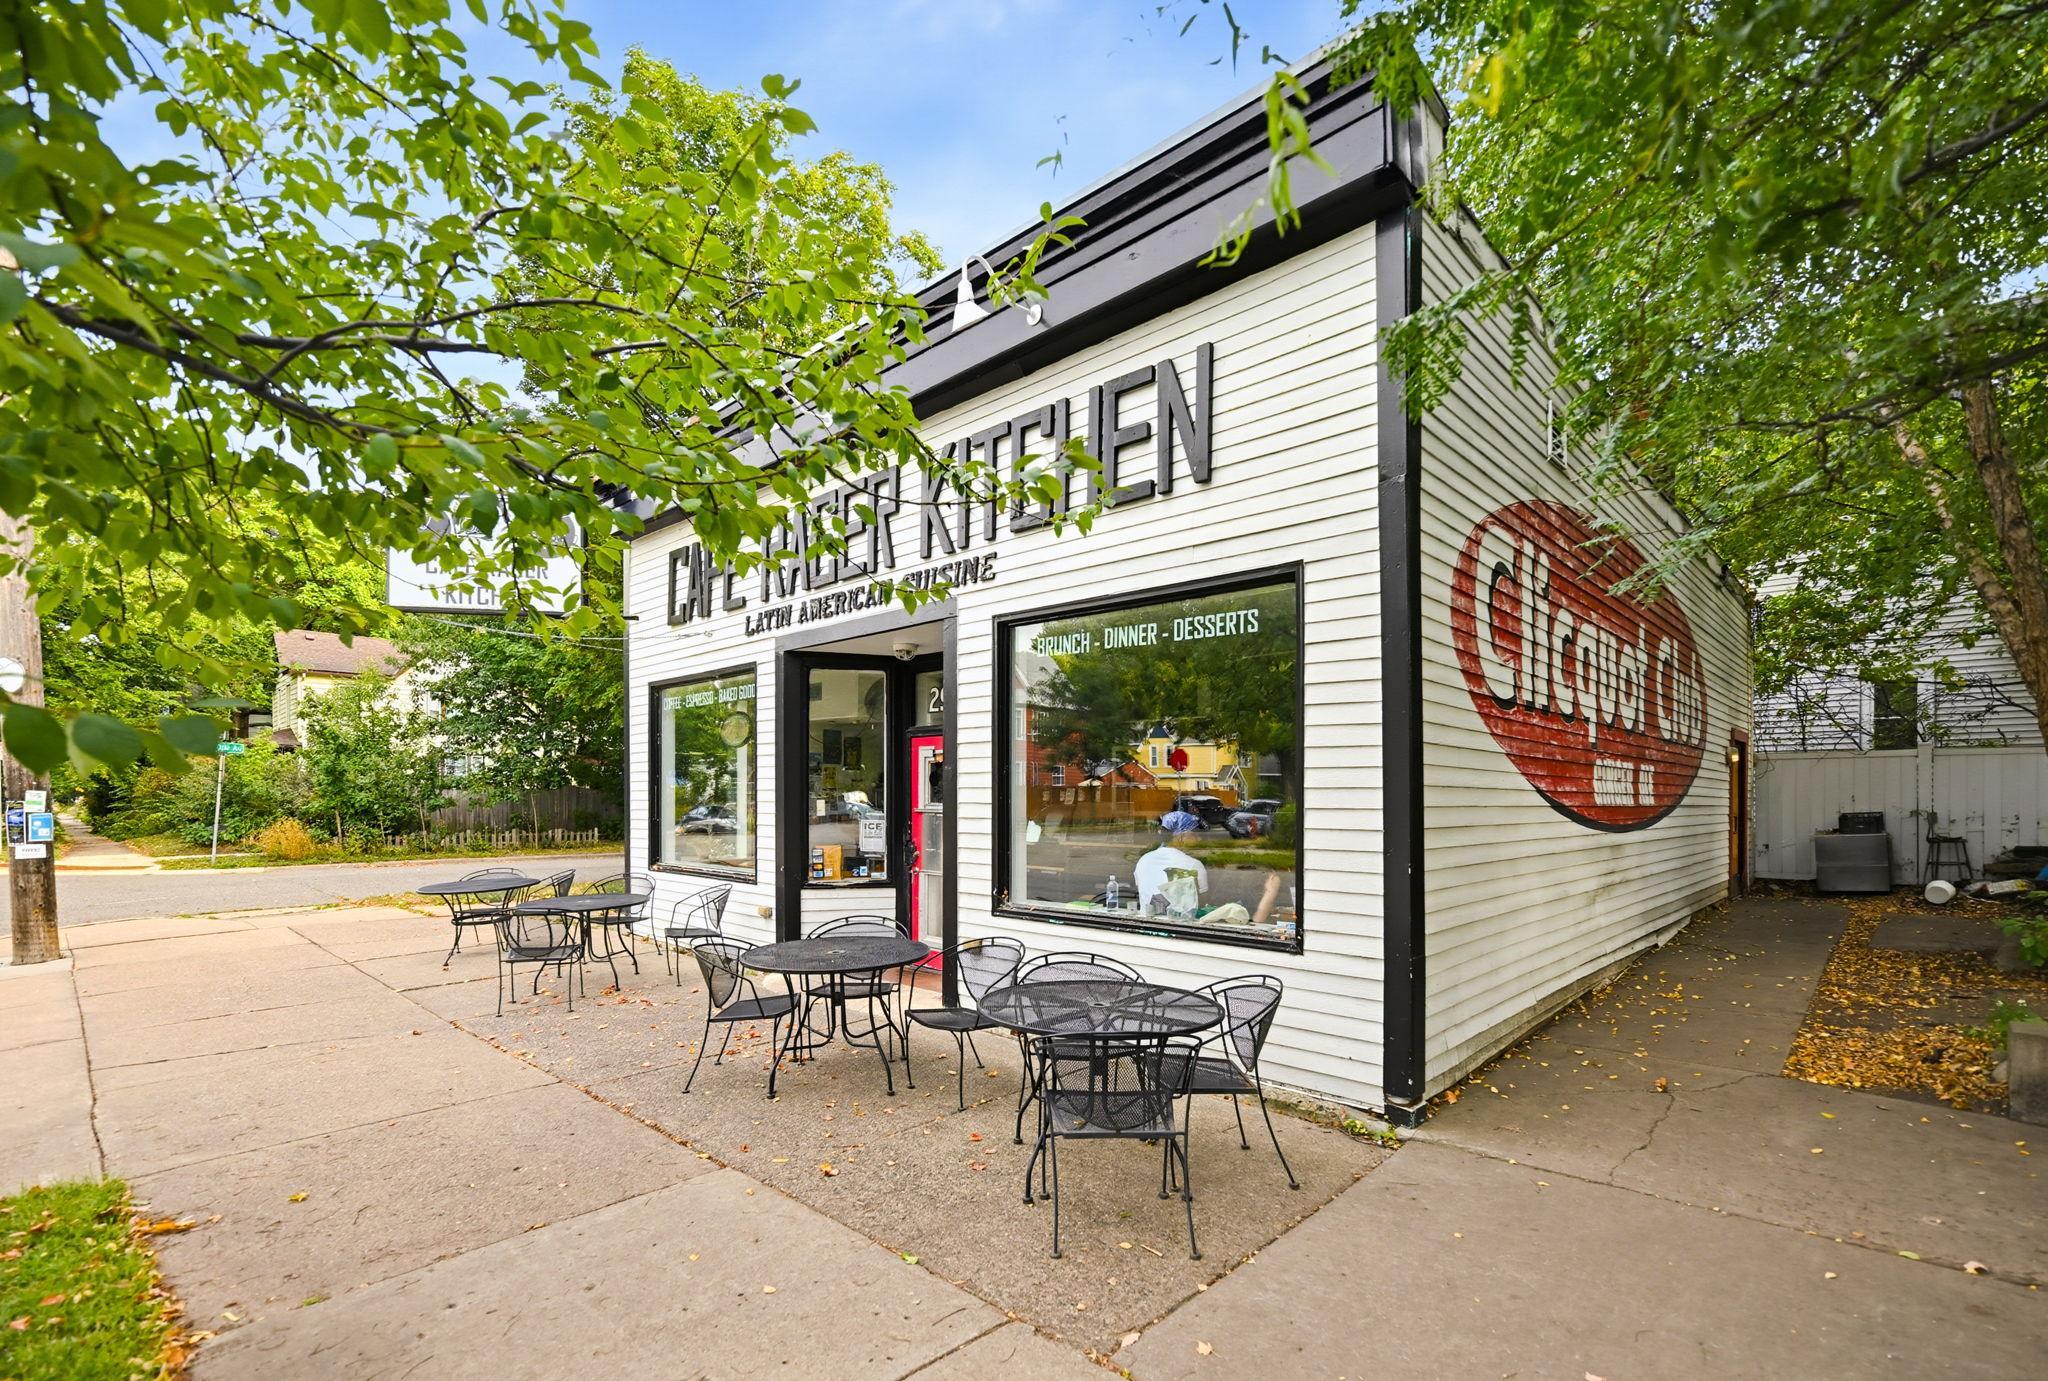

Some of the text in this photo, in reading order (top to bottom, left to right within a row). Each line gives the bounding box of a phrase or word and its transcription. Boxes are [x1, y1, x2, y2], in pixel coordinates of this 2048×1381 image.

[667, 342, 1214, 626] CAFE RACER KITCHEN
[744, 604, 793, 636] LATIN
[1037, 632, 1090, 657] BRUNCH
[1104, 622, 1158, 649] DINNER
[1173, 608, 1259, 642] DESSERTS
[1475, 525, 1702, 746] Clicquot Club
